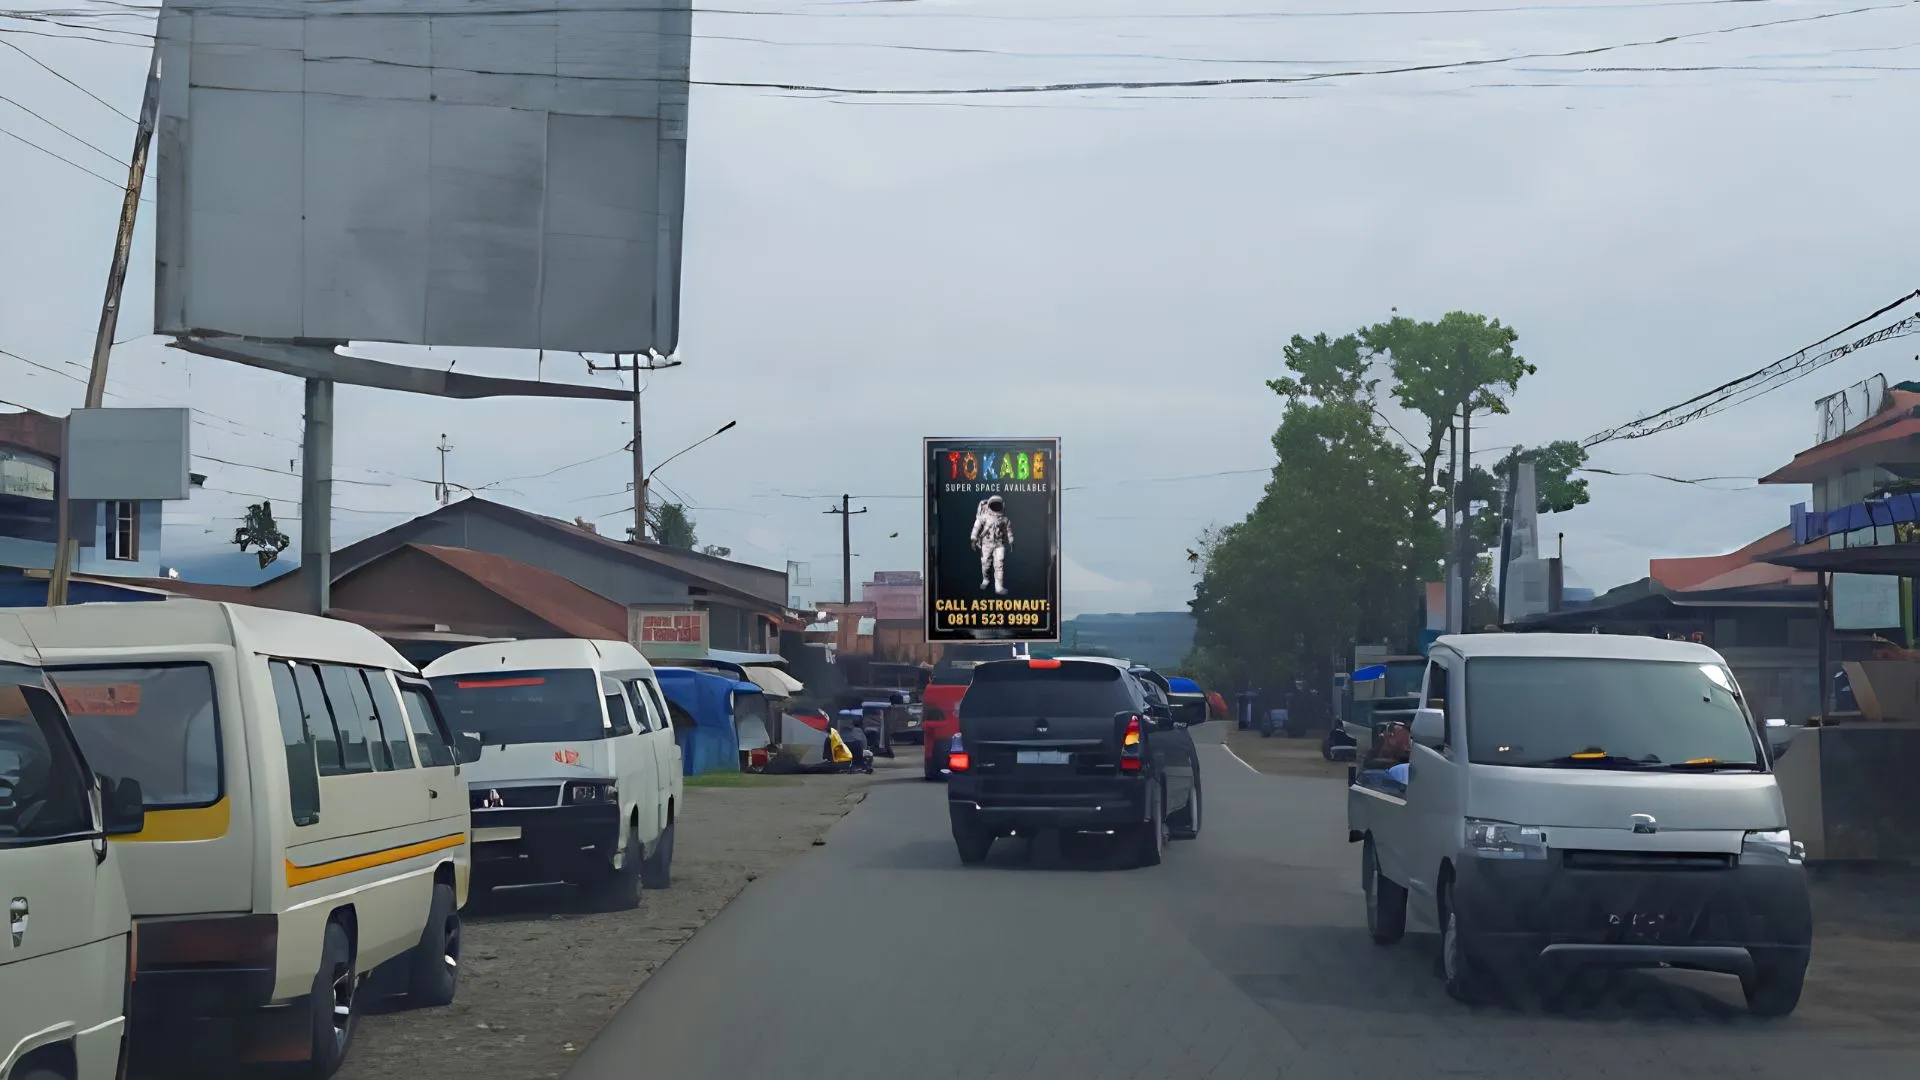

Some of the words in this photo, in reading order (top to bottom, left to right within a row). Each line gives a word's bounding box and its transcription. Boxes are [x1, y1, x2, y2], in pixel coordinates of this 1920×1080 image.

[948, 450, 1044, 480] TOKABE
[945, 483, 972, 492] SUPER
[975, 483, 1001, 492] SPACE
[1004, 483, 1047, 492] AVAILABLE
[936, 599, 968, 612] CALL
[970, 599, 1050, 612] ASTRONAUT:
[948, 613, 977, 625] 0811
[981, 613, 1004, 625] 523
[1008, 613, 1039, 625] 9999
